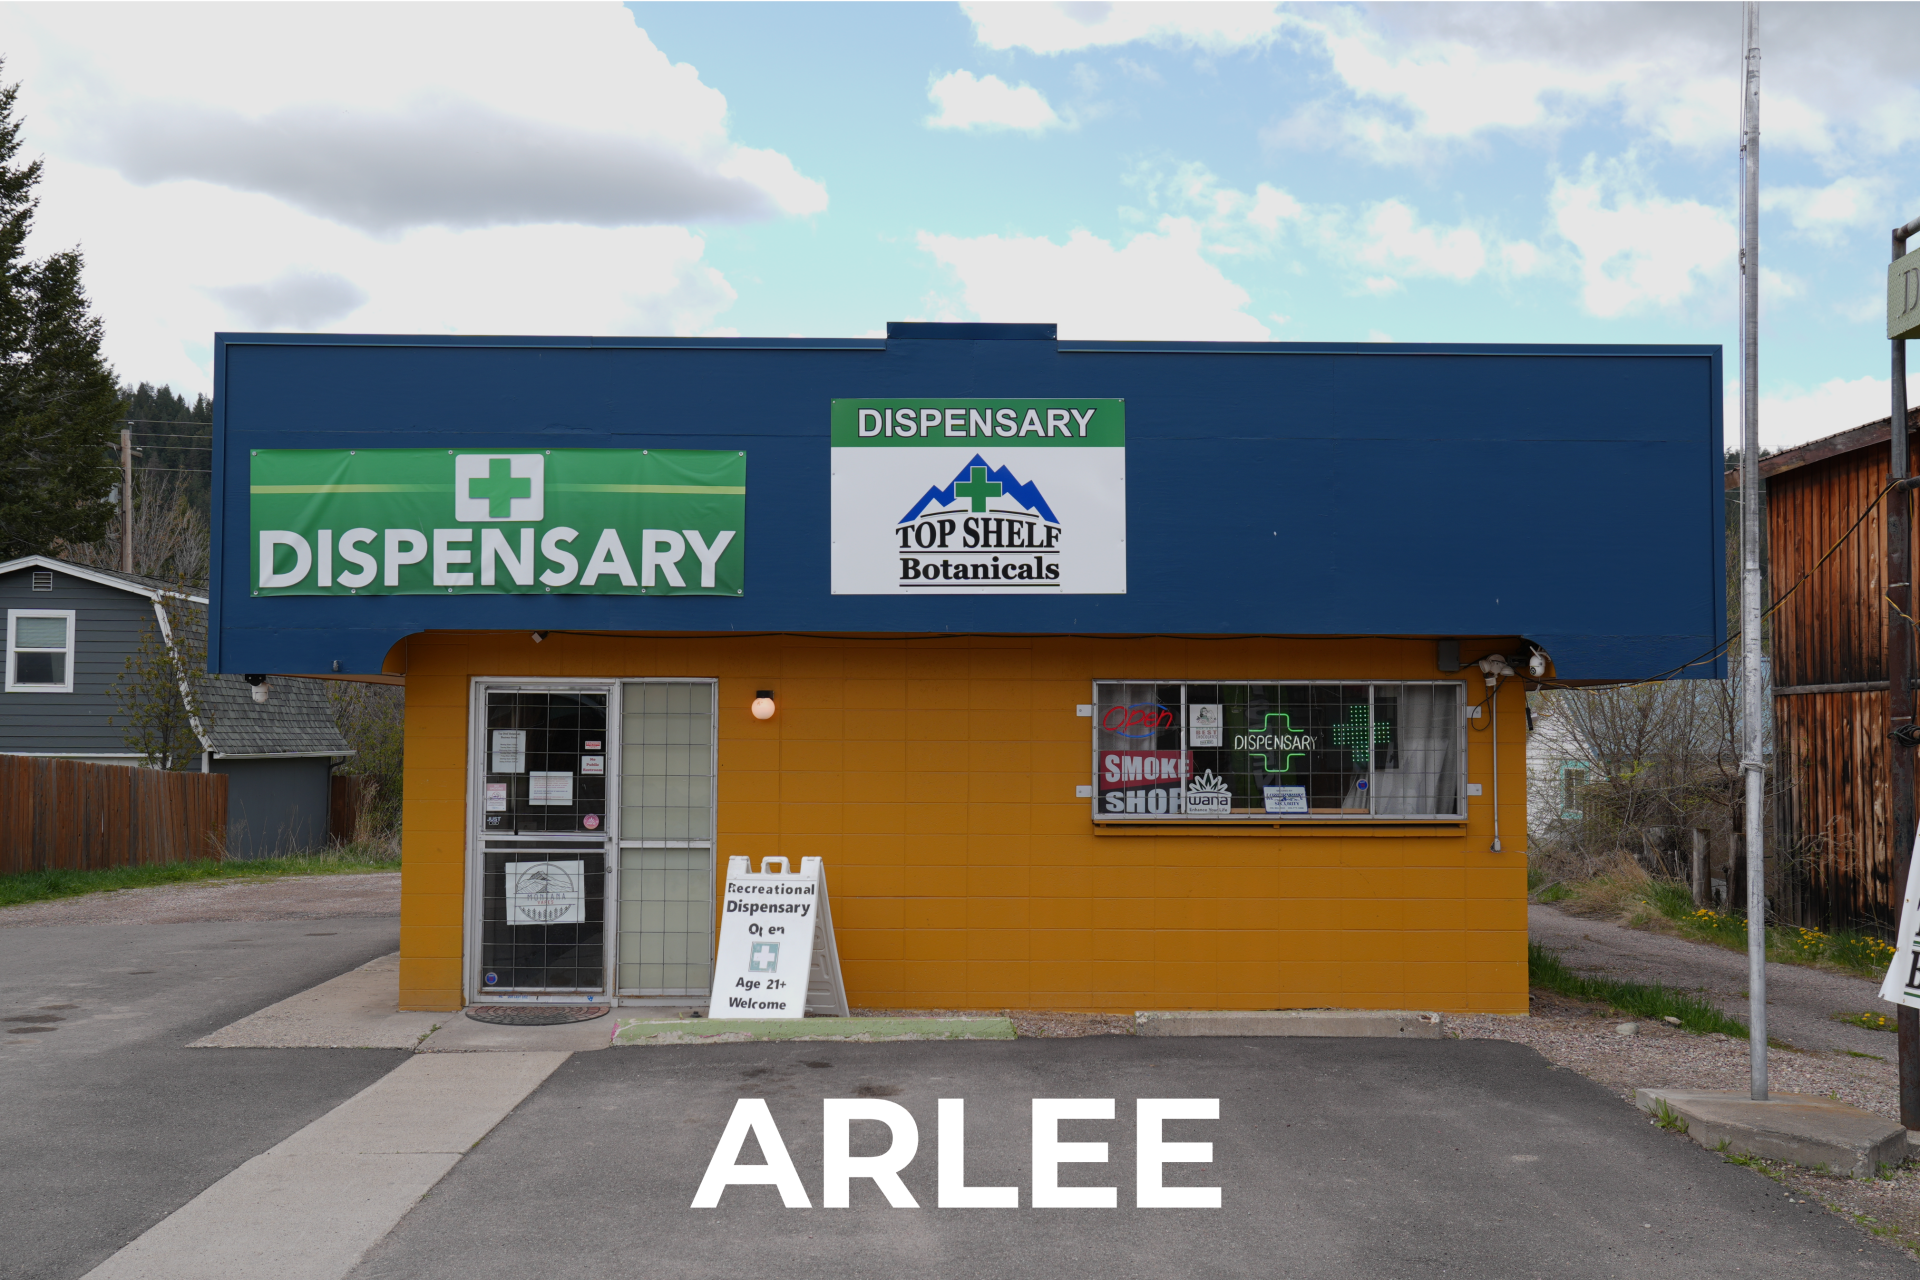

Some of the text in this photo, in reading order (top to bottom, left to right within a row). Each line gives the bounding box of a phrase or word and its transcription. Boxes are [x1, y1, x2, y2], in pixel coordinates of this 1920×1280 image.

[858, 408, 1097, 438] DISPENSARY
[896, 517, 1062, 548] TOP SHELF
[259, 526, 736, 587] DISPENSARY
[899, 556, 1060, 580] Botanicals
[1103, 706, 1173, 733] Open
[1234, 735, 1317, 750] DISPENSARY
[1105, 754, 1190, 783] SMOKE
[1189, 796, 1228, 806] wana
[728, 883, 815, 895] Recreational
[726, 899, 811, 917] Dispensary
[735, 977, 787, 991] Age 21+
[729, 997, 787, 1010] Welcome
